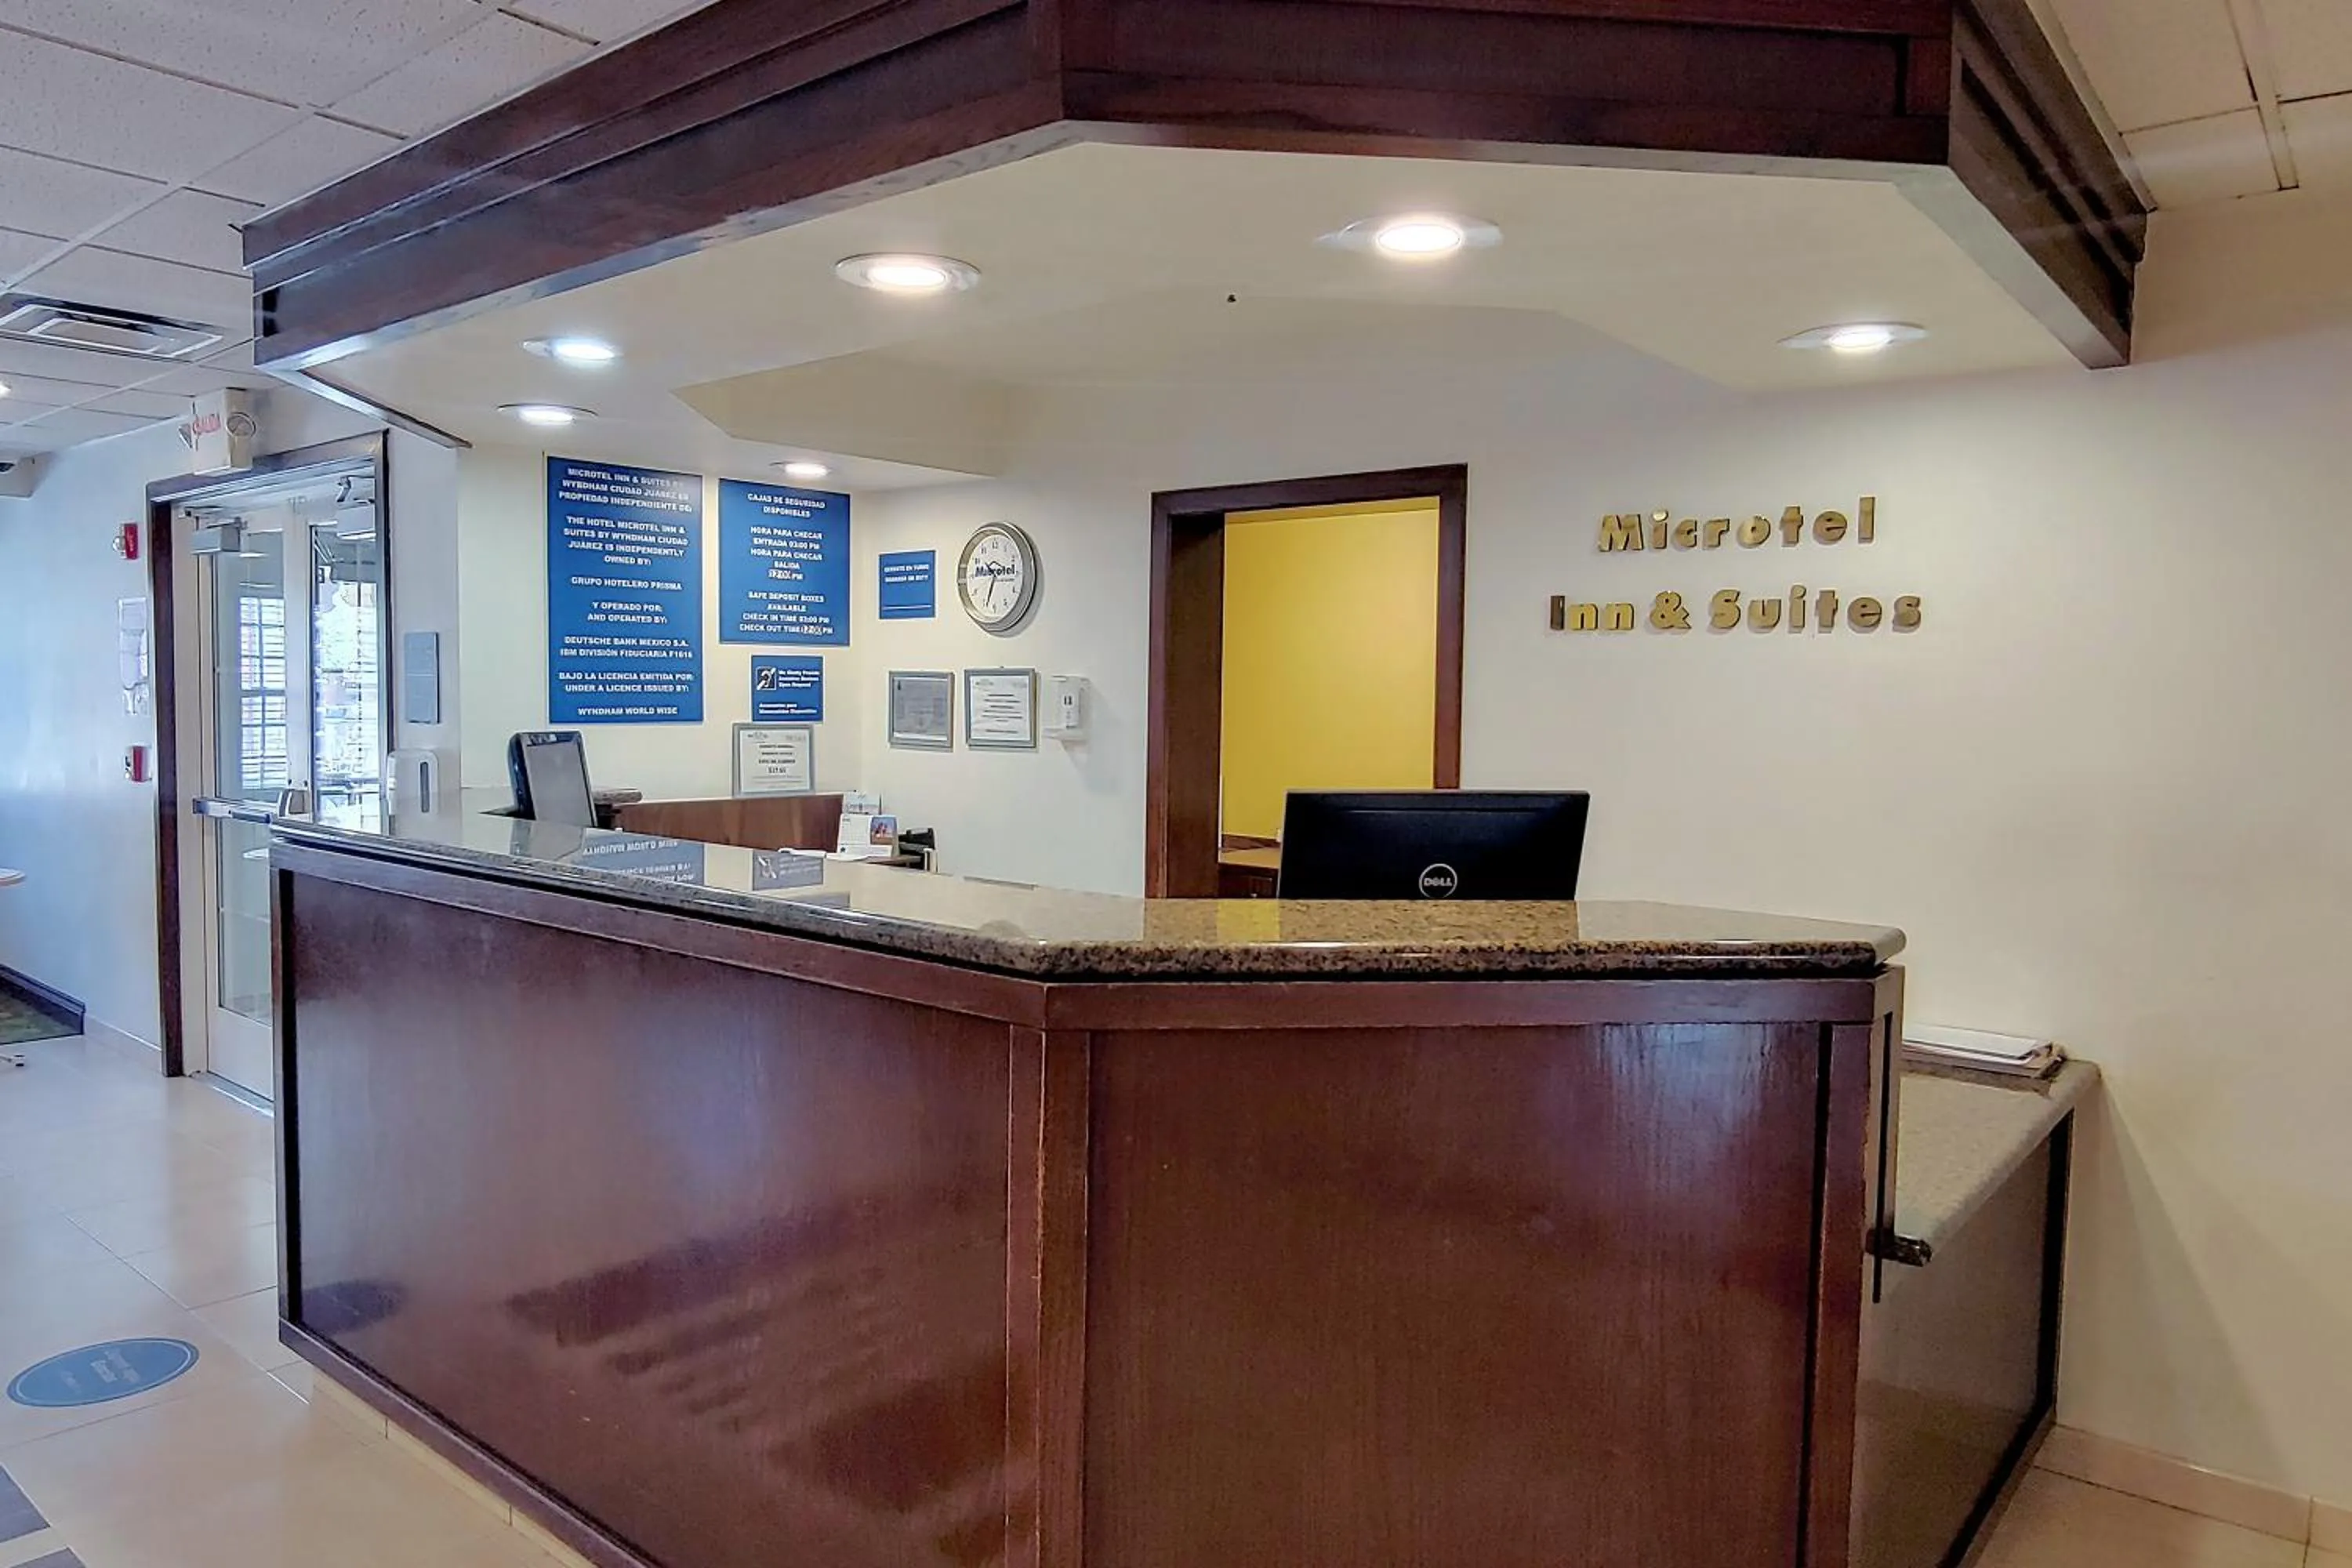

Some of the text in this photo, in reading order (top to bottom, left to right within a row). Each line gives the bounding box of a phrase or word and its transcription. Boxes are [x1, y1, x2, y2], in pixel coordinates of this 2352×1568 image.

[610, 485, 642, 495] CIUDAD
[747, 493, 772, 503] CAJAS
[566, 516, 585, 524] THE
[586, 518, 615, 528] HOTEL
[617, 521, 659, 532] MICROTEL
[1596, 496, 1876, 552] Microtel
[750, 526, 772, 535] HORA
[564, 528, 596, 538] SUITES
[612, 532, 655, 543] WYNDHAM
[657, 536, 689, 546] CIUDAD
[750, 547, 772, 557] HORA
[604, 556, 636, 564] OWNED
[571, 577, 602, 586] GRUPO
[604, 579, 648, 589] HOTELERO
[601, 602, 641, 612] OPERADO
[1549, 585, 1922, 633] Inn & Suites
[608, 614, 652, 623] OPERATED
[742, 612, 769, 621] CHECK
[739, 623, 765, 632] CHECK
[564, 636, 612, 645] DEUTSCHE
[613, 637, 637, 646] BANK
[619, 649, 667, 658] FIDUCIARIA
[598, 672, 638, 681] LICENCIA
[1424, 877, 1452, 886] DELL
